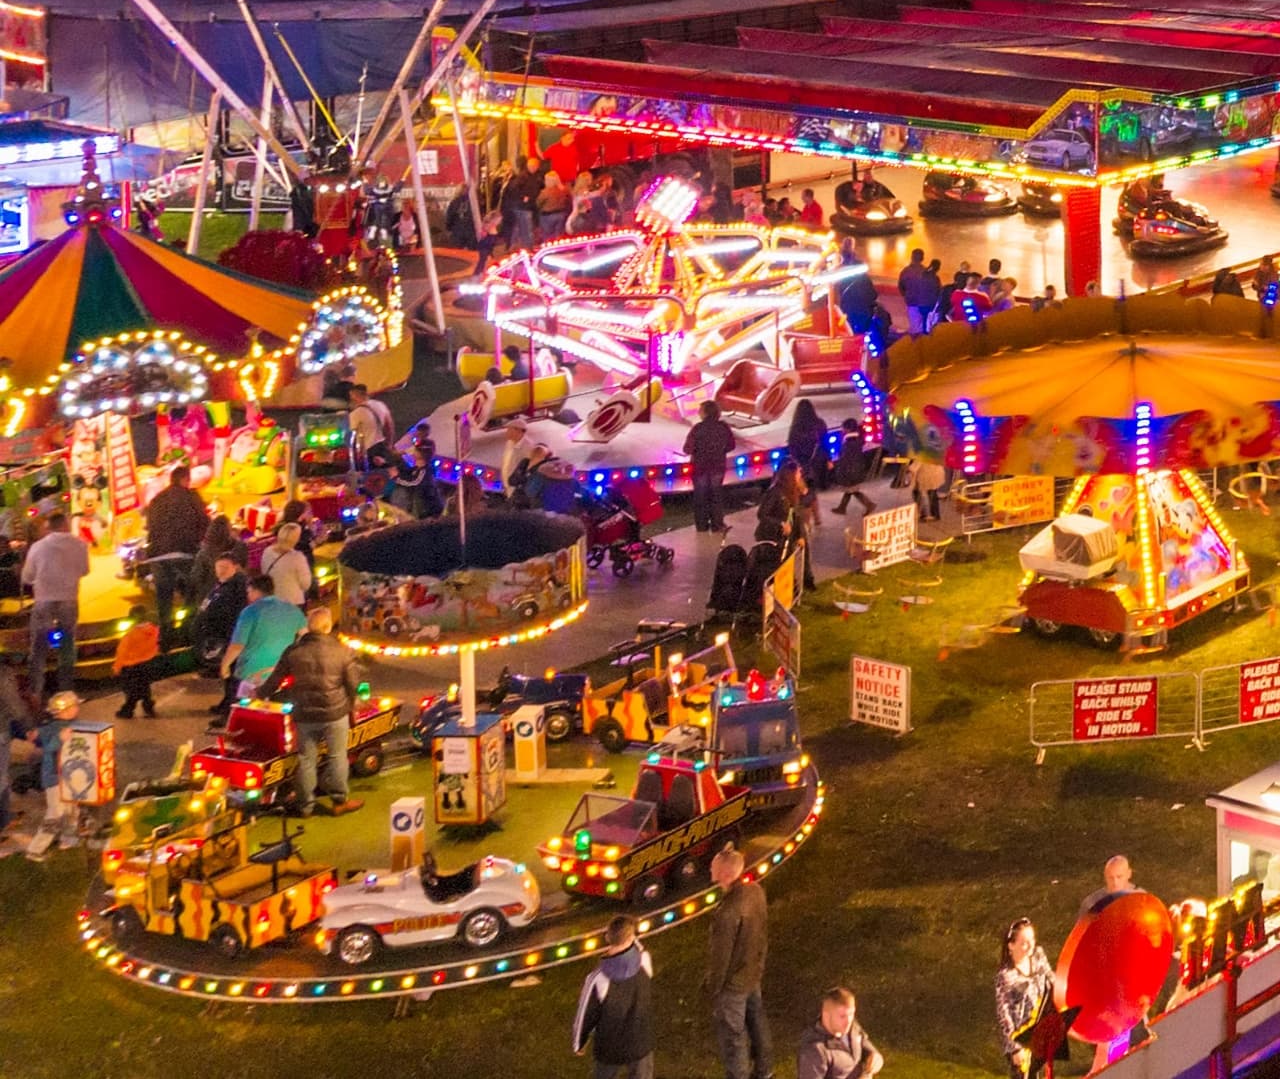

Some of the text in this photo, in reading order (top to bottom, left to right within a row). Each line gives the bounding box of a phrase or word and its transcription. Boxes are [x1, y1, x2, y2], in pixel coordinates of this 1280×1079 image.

[1003, 494, 1044, 507] FLYING
[869, 507, 912, 528] SAFETY
[870, 522, 912, 542] NOTICE
[855, 660, 902, 681] SAFETY
[1244, 663, 1279, 680] PLEASE
[856, 677, 901, 698] NOTICE
[1077, 681, 1153, 697] PLEASE STAND
[1247, 676, 1273, 692] BACK
[855, 691, 903, 709] STAND BACK
[1080, 694, 1149, 710] BACK WHILST
[857, 702, 901, 718] WHILE RIDE
[1095, 709, 1134, 723] RIDE IS
[1253, 705, 1264, 718] IN
[858, 711, 900, 727] IN MOTION
[1087, 721, 1142, 737] IN MOTION
